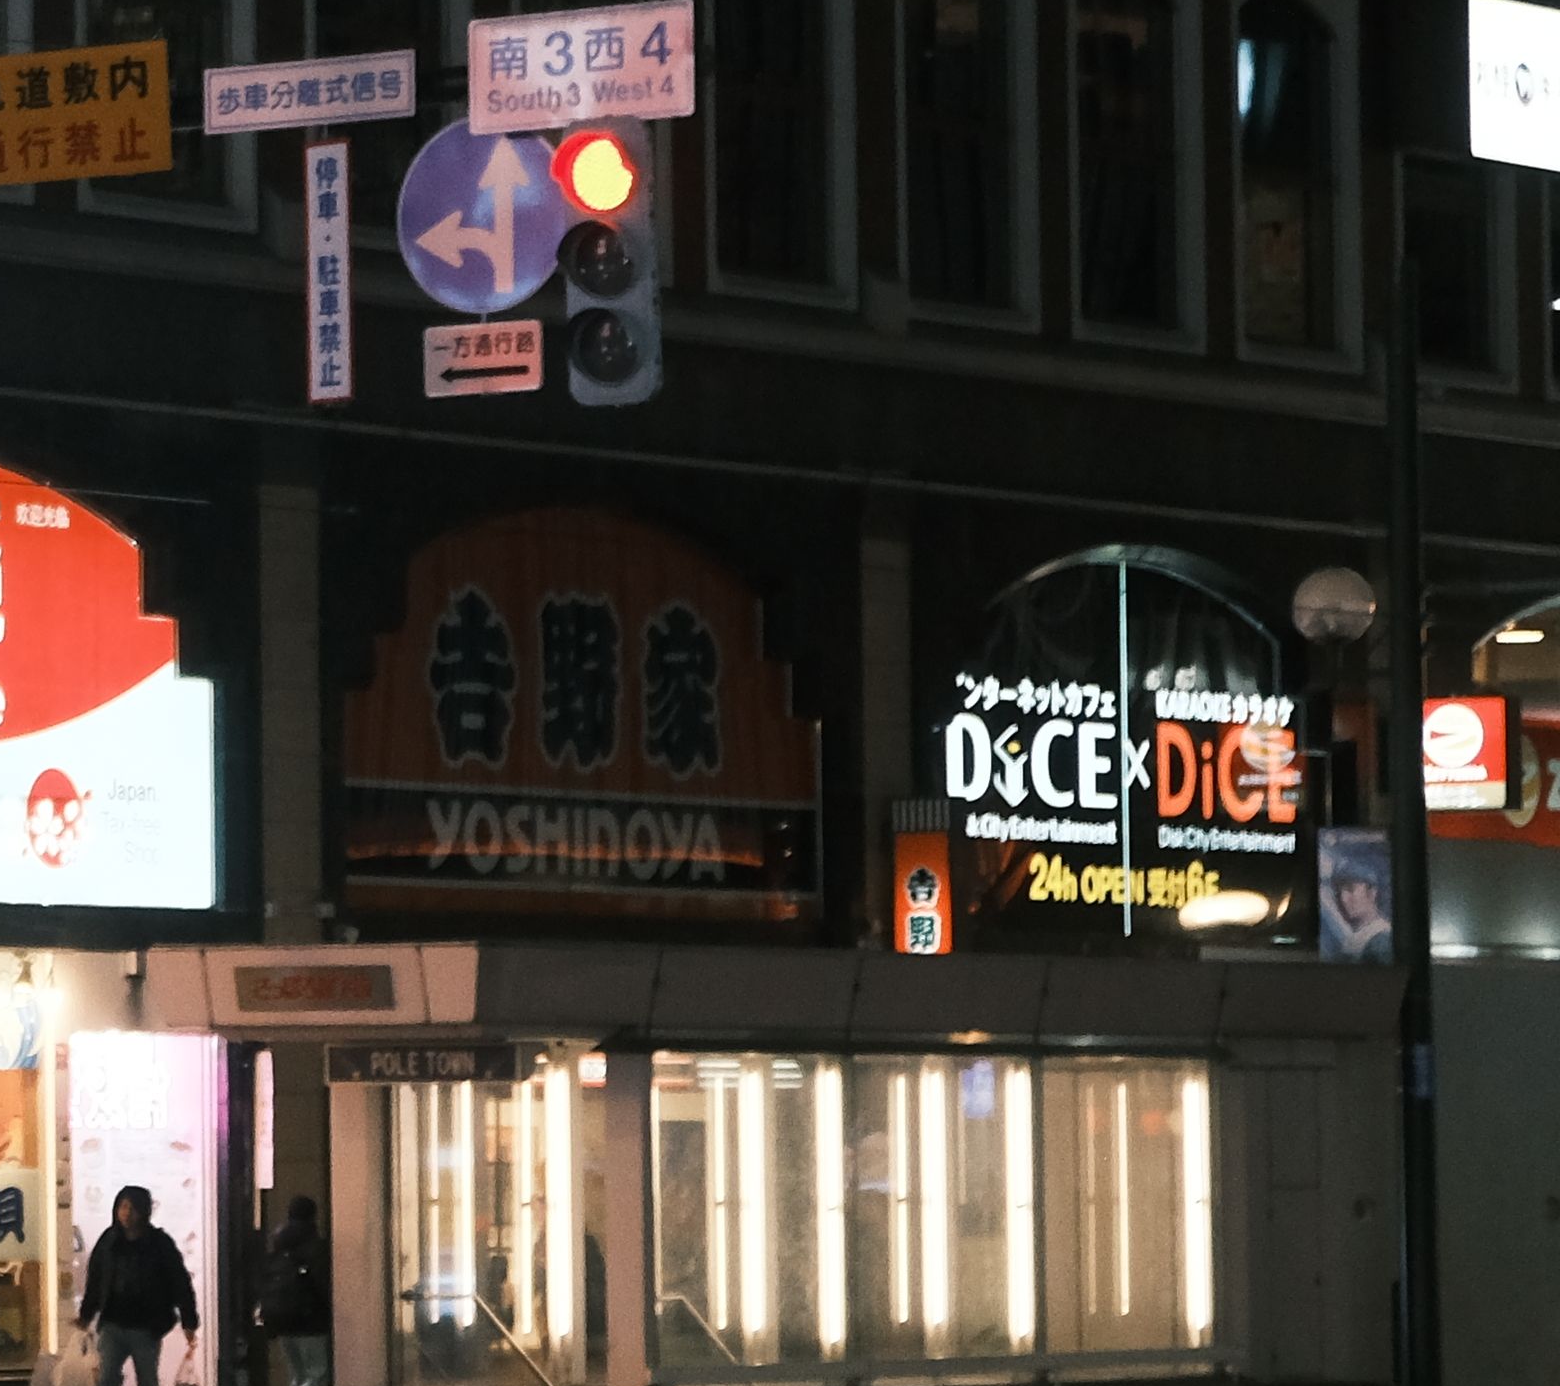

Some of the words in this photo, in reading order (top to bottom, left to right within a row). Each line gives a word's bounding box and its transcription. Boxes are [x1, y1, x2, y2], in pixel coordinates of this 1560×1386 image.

[488, 20, 674, 82] 南3西4
[216, 69, 402, 116] 歩車分離式信号
[487, 86, 562, 113] South
[566, 81, 582, 107] 3
[592, 77, 653, 104] West
[660, 75, 674, 97] 4
[1156, 721, 1297, 824] DiCE
[1028, 852, 1077, 903] 24h
[1080, 864, 1145, 905] OPEN
[370, 1050, 419, 1075] POLE
[426, 1051, 477, 1077] TOWN
